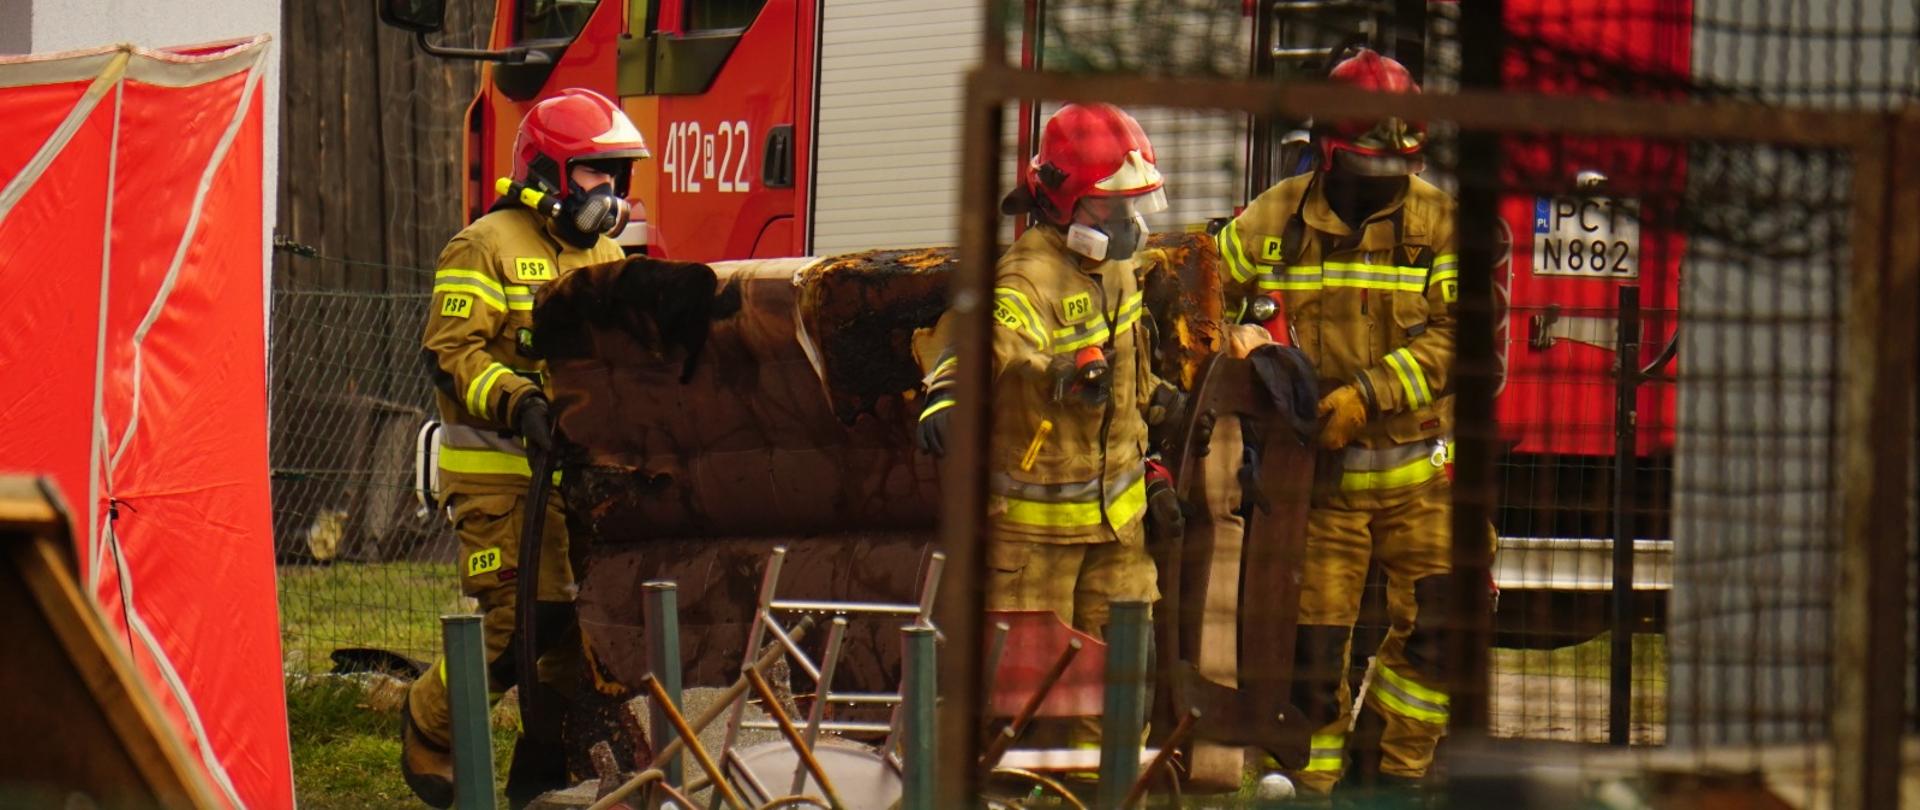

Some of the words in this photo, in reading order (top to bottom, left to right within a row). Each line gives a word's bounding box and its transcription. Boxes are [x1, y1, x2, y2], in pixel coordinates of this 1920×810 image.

[1537, 218, 1549, 228] PL
[1543, 238, 1630, 272] N882
[520, 262, 545, 276] PSP
[445, 298, 467, 312] PSP
[1068, 297, 1090, 317] PSP
[472, 552, 496, 571] PSP
